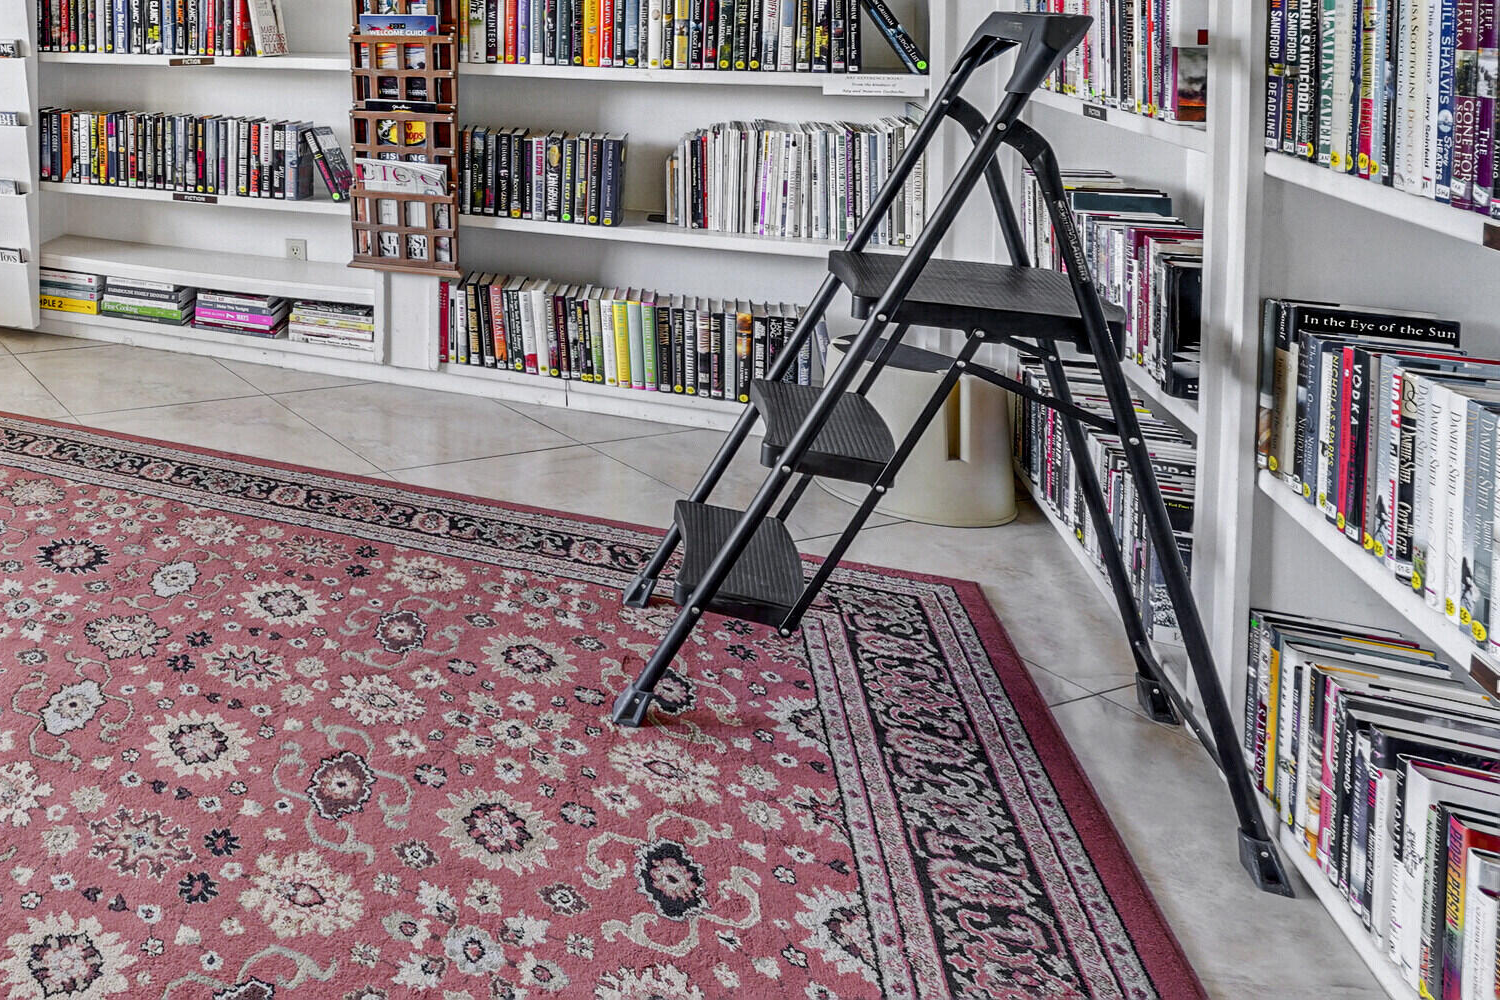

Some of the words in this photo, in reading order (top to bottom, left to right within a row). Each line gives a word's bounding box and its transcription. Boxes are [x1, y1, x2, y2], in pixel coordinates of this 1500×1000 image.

[150, 1, 159, 24] CLANCY
[488, 11, 496, 48] WINTERS
[739, 4, 748, 24] FIRM
[876, 4, 894, 26] GRISHAM
[1464, 2, 1473, 33] JEFF
[1484, 3, 1493, 29] JEFF
[1269, 10, 1282, 59] SANDFORD
[1286, 12, 1298, 61] SANDFORD
[1298, 36, 1309, 112] SANDFORD
[1409, 25, 1419, 101] SCOTTOLINE
[1440, 41, 1451, 104] SHALVIS
[1267, 82, 1278, 136] DEADLINE
[1285, 83, 1294, 111] STORM
[251, 125, 259, 155] ROBERT
[1285, 112, 1293, 139] FRONT
[1320, 95, 1332, 146] CAPER
[1453, 104, 1462, 176] SOLDIERS
[1462, 100, 1474, 147] GONE
[1436, 139, 1444, 180] HEARTS
[1479, 128, 1489, 156] THE
[1461, 153, 1471, 182] FOR
[58, 299, 63, 308] 2
[115, 304, 138, 314] Cooking
[493, 294, 502, 316] JOHN
[495, 318, 504, 340] HART
[1304, 314, 1319, 325] In
[1323, 317, 1345, 328] the
[1350, 319, 1375, 332] Eye
[1379, 323, 1397, 333] of
[1400, 324, 1424, 336] the
[1429, 327, 1456, 339] Sun
[1330, 355, 1338, 419] NICHOLAS
[1350, 364, 1362, 425] VODKA
[1296, 416, 1306, 464] NICHOLAS
[1480, 418, 1494, 474] DANIELLE
[1477, 477, 1493, 510] STEEL
[1397, 499, 1410, 551] COTTAGE
[1343, 730, 1353, 794] Monopoly
[1446, 877, 1460, 929] PERSON
